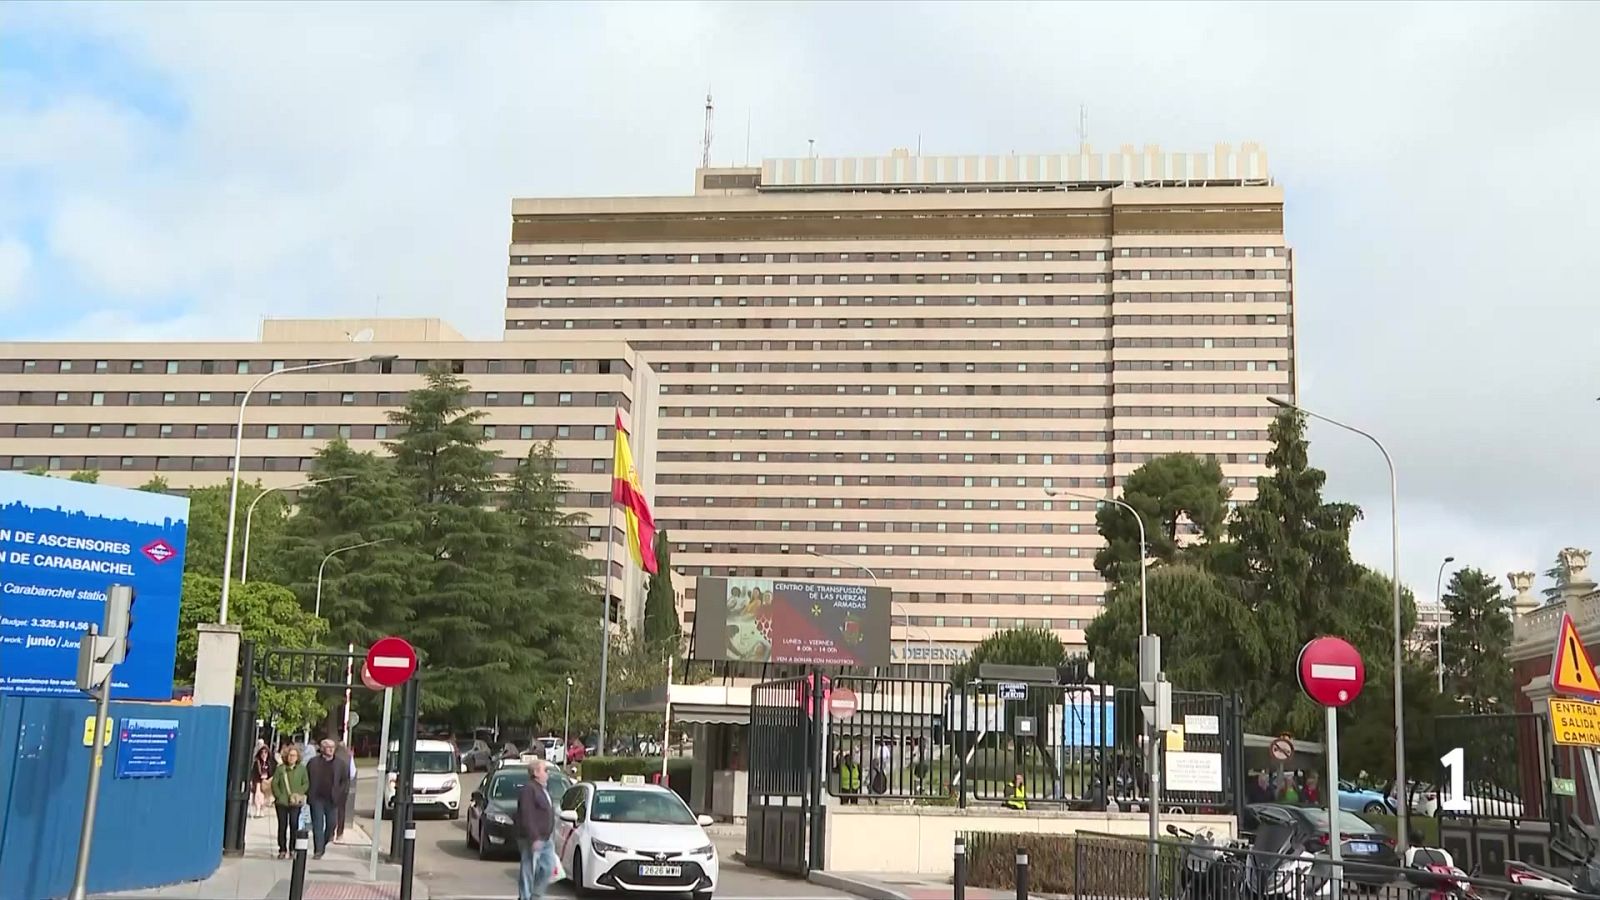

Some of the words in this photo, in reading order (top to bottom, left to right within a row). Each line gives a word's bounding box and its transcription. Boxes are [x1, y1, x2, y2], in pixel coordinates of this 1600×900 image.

[15, 531, 35, 544] DE
[37, 534, 131, 555] ASCENSORES
[10, 552, 30, 565] DE
[34, 554, 136, 576] CARABANCHEL
[4, 582, 76, 599] Carabanchel
[775, 583, 803, 591] CENTRO
[809, 592, 818, 600] DE
[835, 593, 866, 601] FUERZAS
[833, 601, 866, 609] ARMADAS
[902, 647, 968, 660] DEFENSA
[1555, 703, 1597, 715] ENTRADA
[1561, 718, 1594, 728] SALIDA
